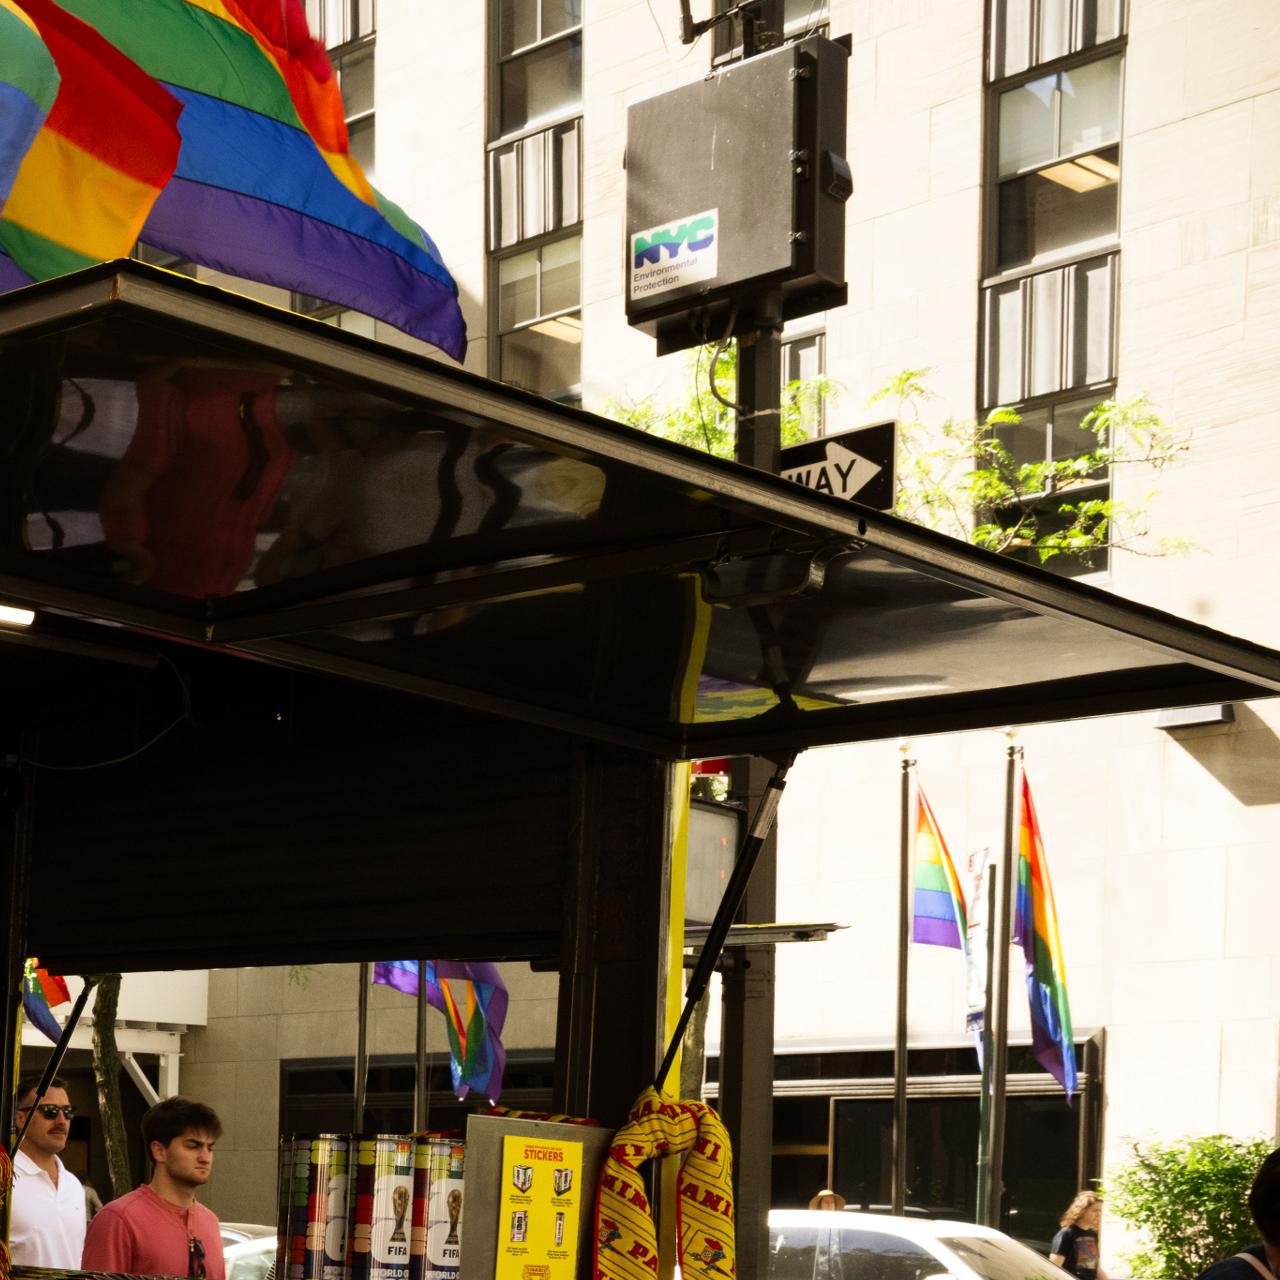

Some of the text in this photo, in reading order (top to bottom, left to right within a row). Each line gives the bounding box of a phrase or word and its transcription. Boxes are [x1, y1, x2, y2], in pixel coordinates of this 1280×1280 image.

[634, 216, 714, 269] NYC
[633, 257, 698, 282] Environmental
[633, 274, 680, 294] Protection
[524, 1149, 564, 1162] STICKERS
[388, 1246, 408, 1256] FIFA
[442, 1249, 460, 1258] FIFA
[369, 1268, 403, 1278] WORLD
[425, 1270, 455, 1280] WORLD
